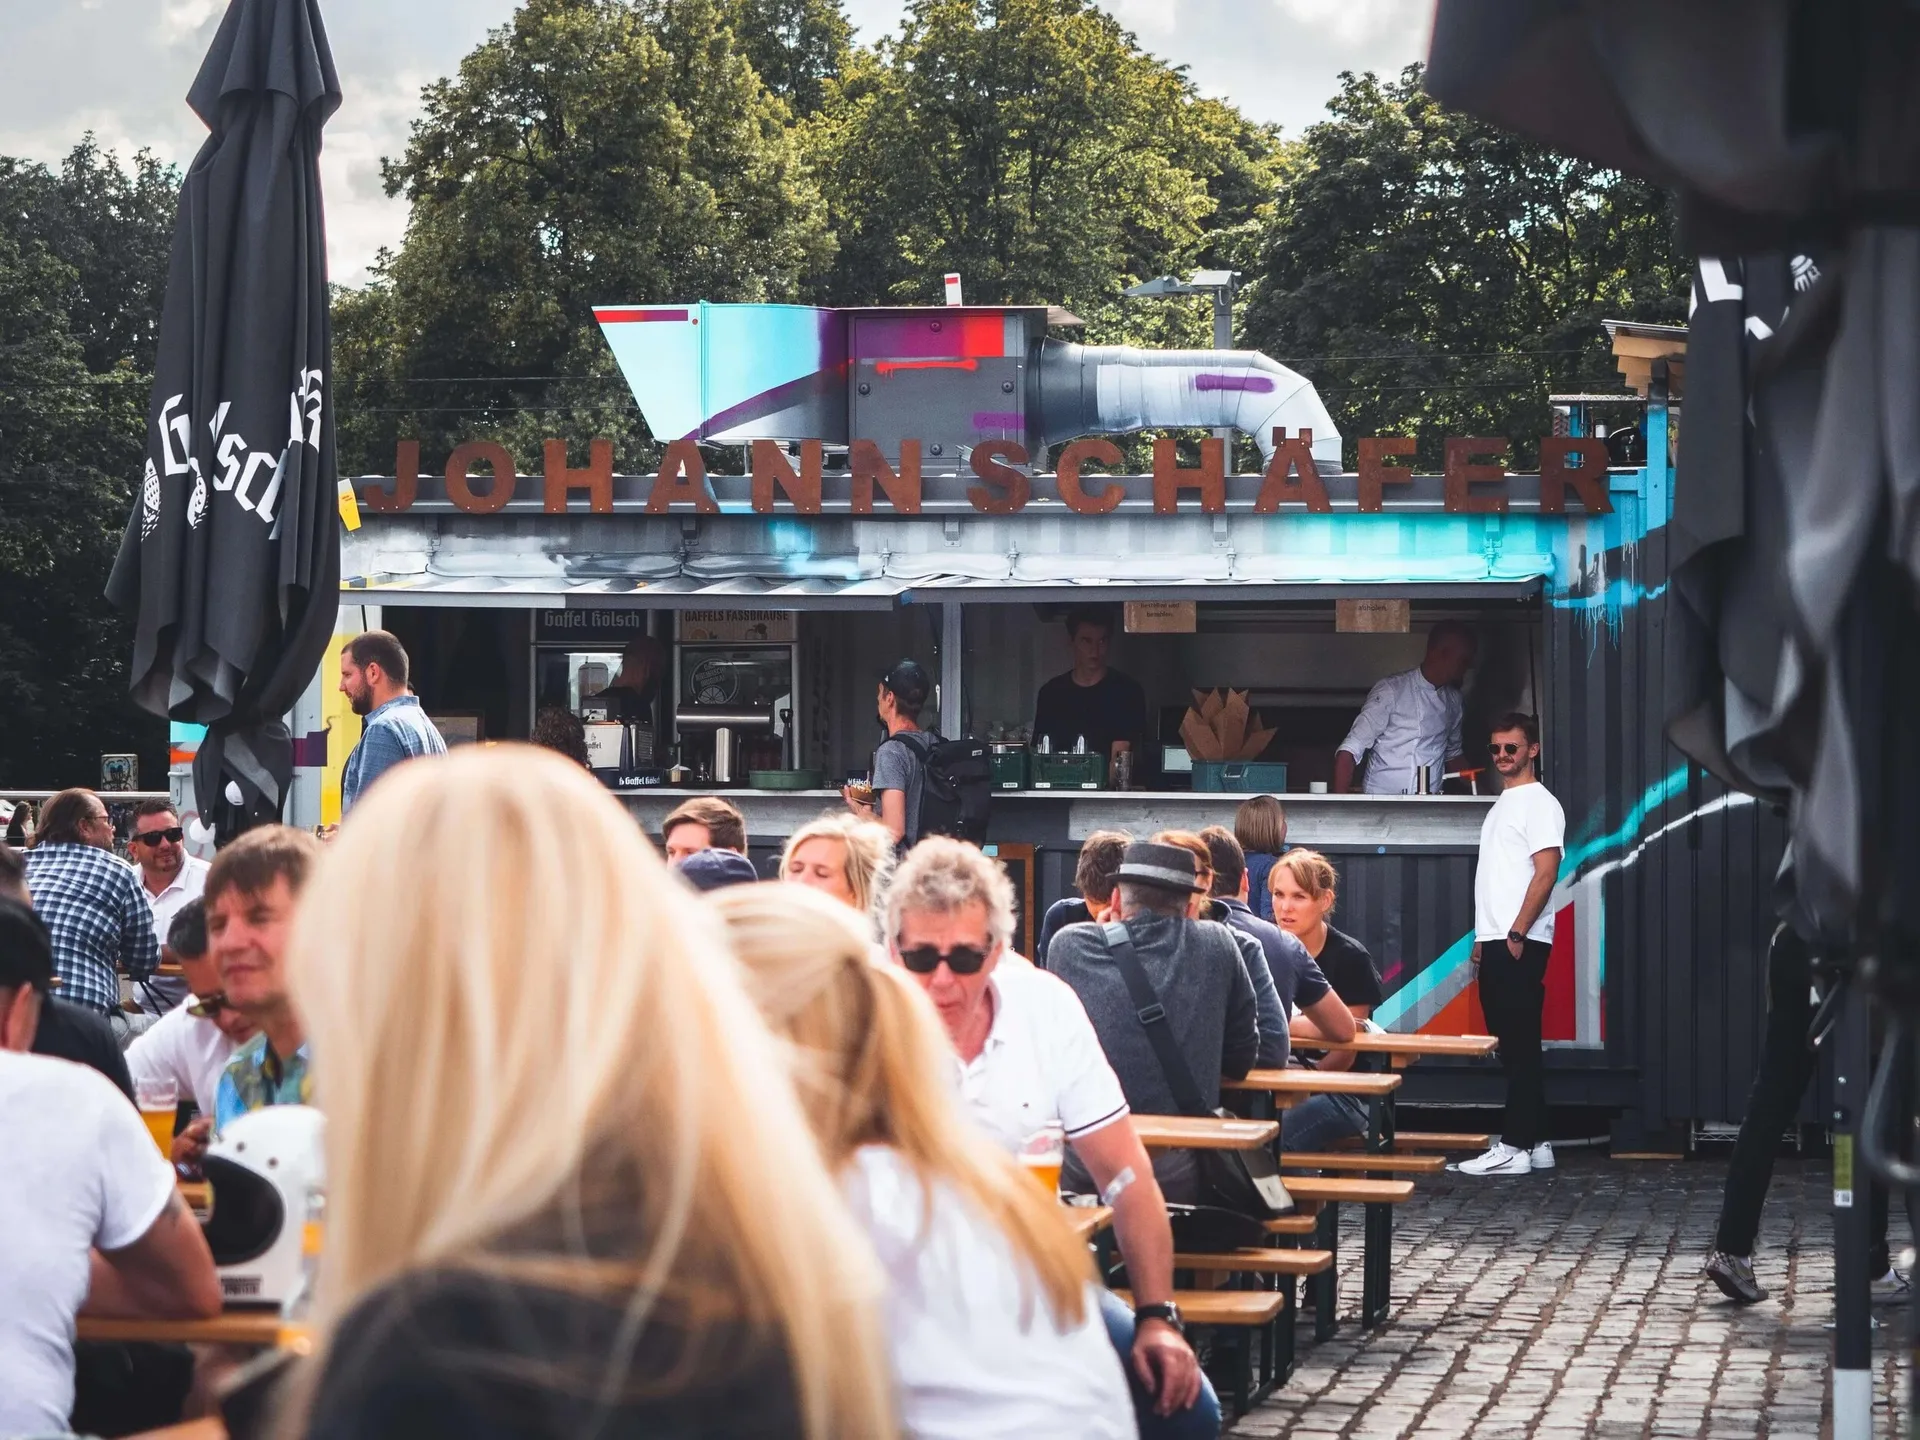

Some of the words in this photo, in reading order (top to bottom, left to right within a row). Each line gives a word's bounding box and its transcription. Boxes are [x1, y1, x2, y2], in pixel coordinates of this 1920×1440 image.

[362, 439, 922, 515] JOHANN
[966, 426, 1613, 515] SCHÄFER
[544, 610, 588, 628] Gaffel
[591, 610, 640, 628] Kölsch
[625, 776, 645, 786] Gaffel
